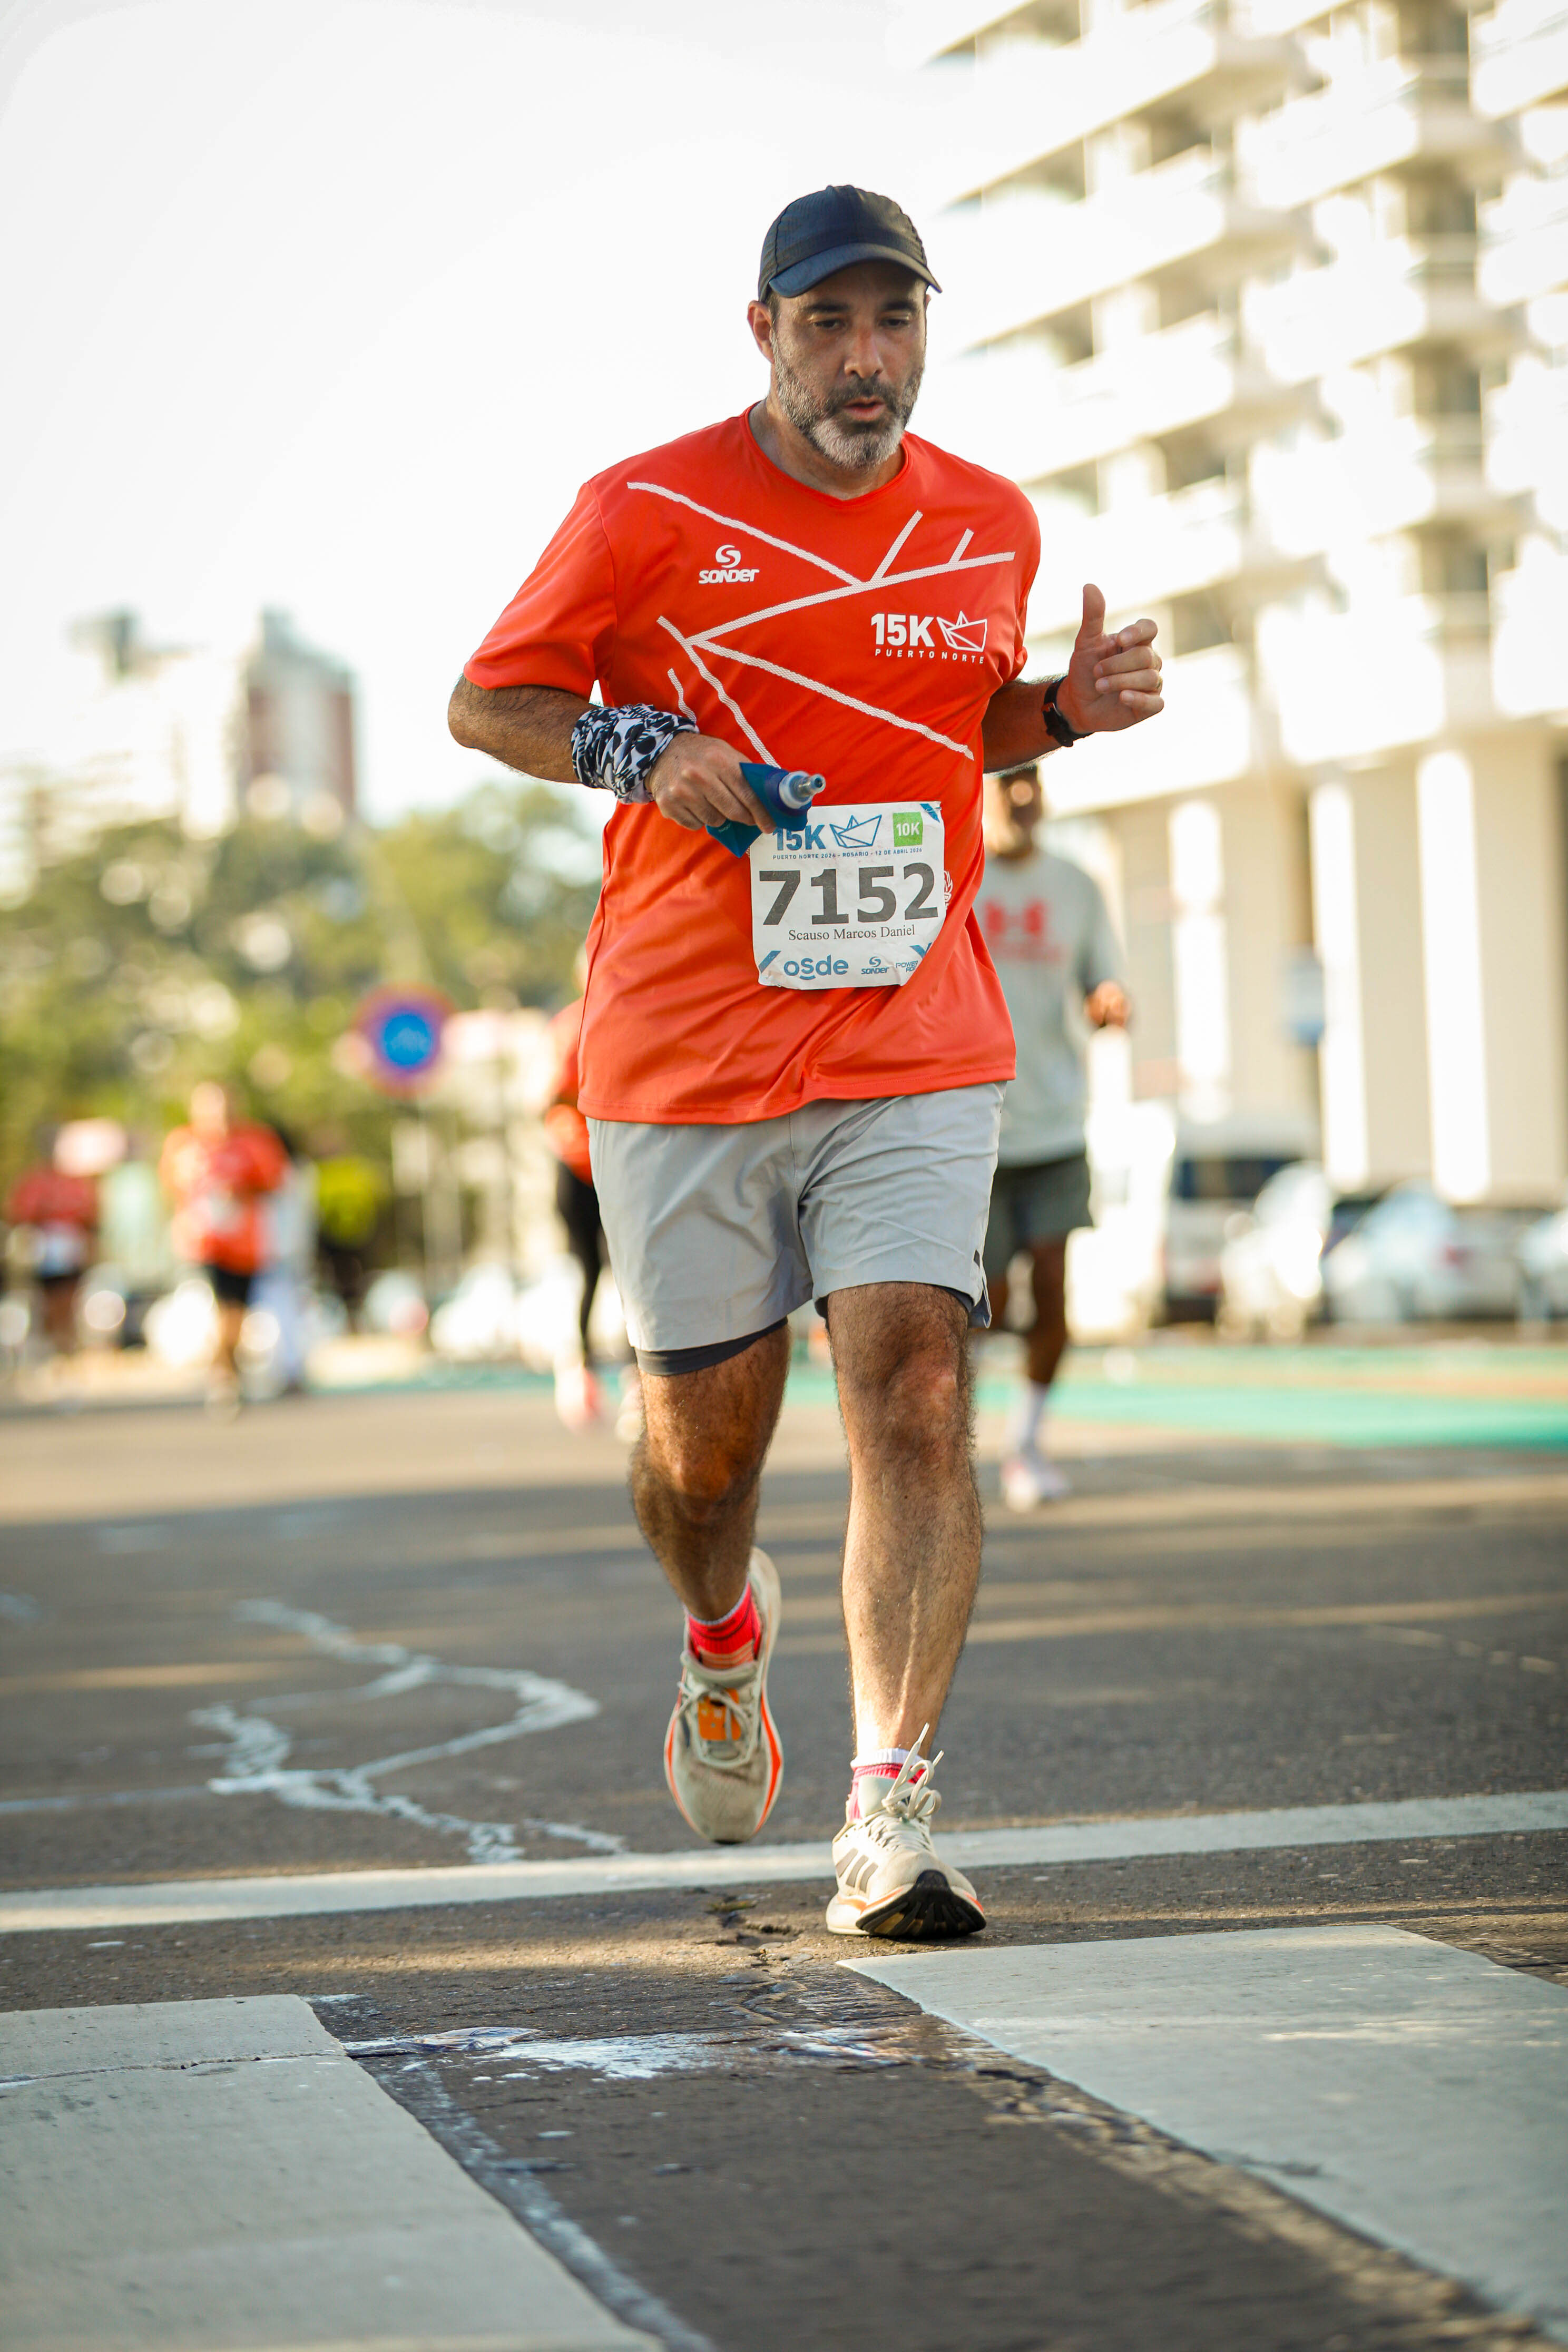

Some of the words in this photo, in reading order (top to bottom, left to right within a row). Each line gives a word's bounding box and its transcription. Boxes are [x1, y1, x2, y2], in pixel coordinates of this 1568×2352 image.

[870, 613, 935, 647] 15K
[875, 648, 935, 659] PUERTO
[942, 651, 984, 664] NORTE
[772, 824, 826, 851] 15K
[896, 821, 920, 837] 10K
[759, 862, 938, 925] 7152
[788, 929, 829, 940] Scauso
[834, 928, 877, 939] Marcos
[880, 925, 915, 937] Daniel
[783, 954, 849, 976] osde
